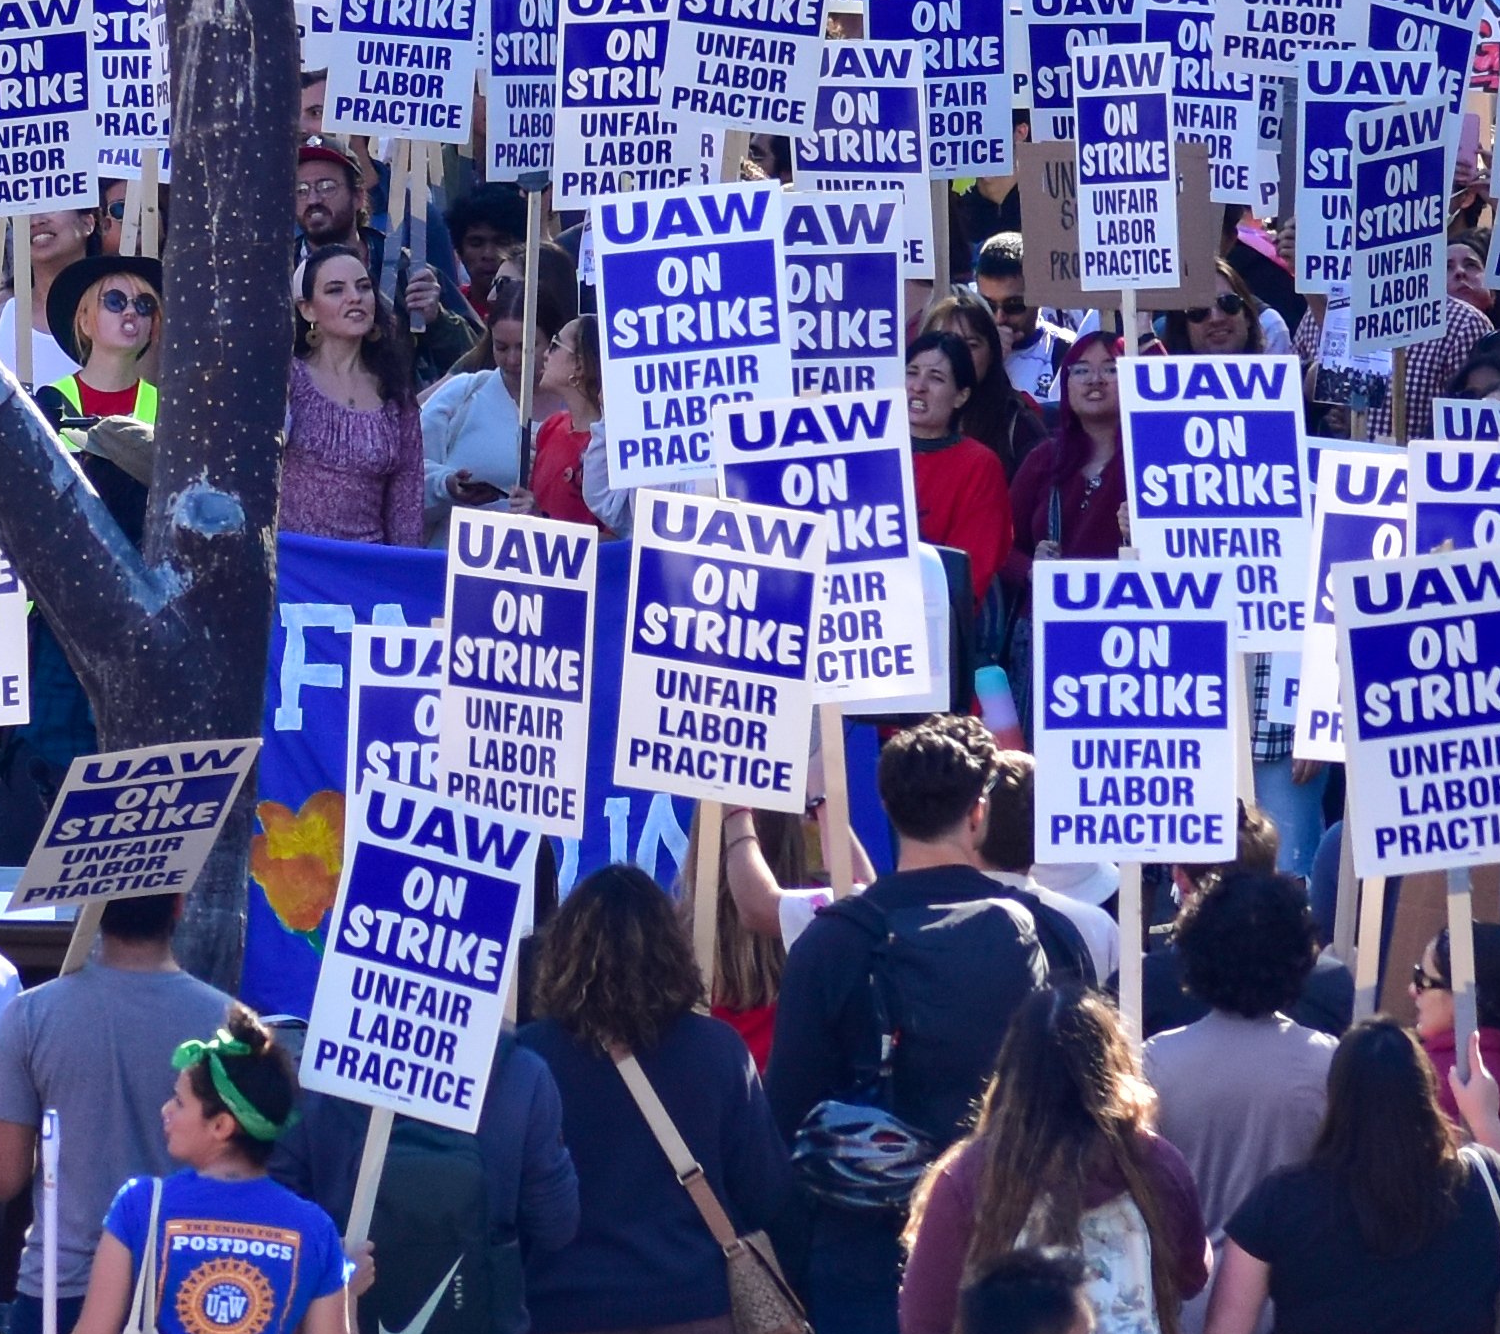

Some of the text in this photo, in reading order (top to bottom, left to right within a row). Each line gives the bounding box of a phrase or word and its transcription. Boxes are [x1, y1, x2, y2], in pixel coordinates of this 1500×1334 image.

[1052, 571, 1222, 611] UAW
[1100, 624, 1169, 669] ON
[1049, 672, 1222, 718] STRIKE
[1071, 738, 1200, 770] UNFAIR
[1078, 775, 1194, 807] LABOR
[365, 789, 530, 871] UAW
[1050, 812, 1222, 845] PRACTICE
[401, 865, 467, 920] ON
[342, 903, 502, 981] STRIKE
[350, 966, 472, 1028] UNFAIR
[347, 1006, 457, 1064] LABOR
[313, 1038, 475, 1110] PRACTICE
[172, 1236, 293, 1261] POSTDOCS
[215, 1225, 253, 1235] UNION
[258, 1229, 281, 1238] FOR
[205, 1293, 247, 1323] UAW
